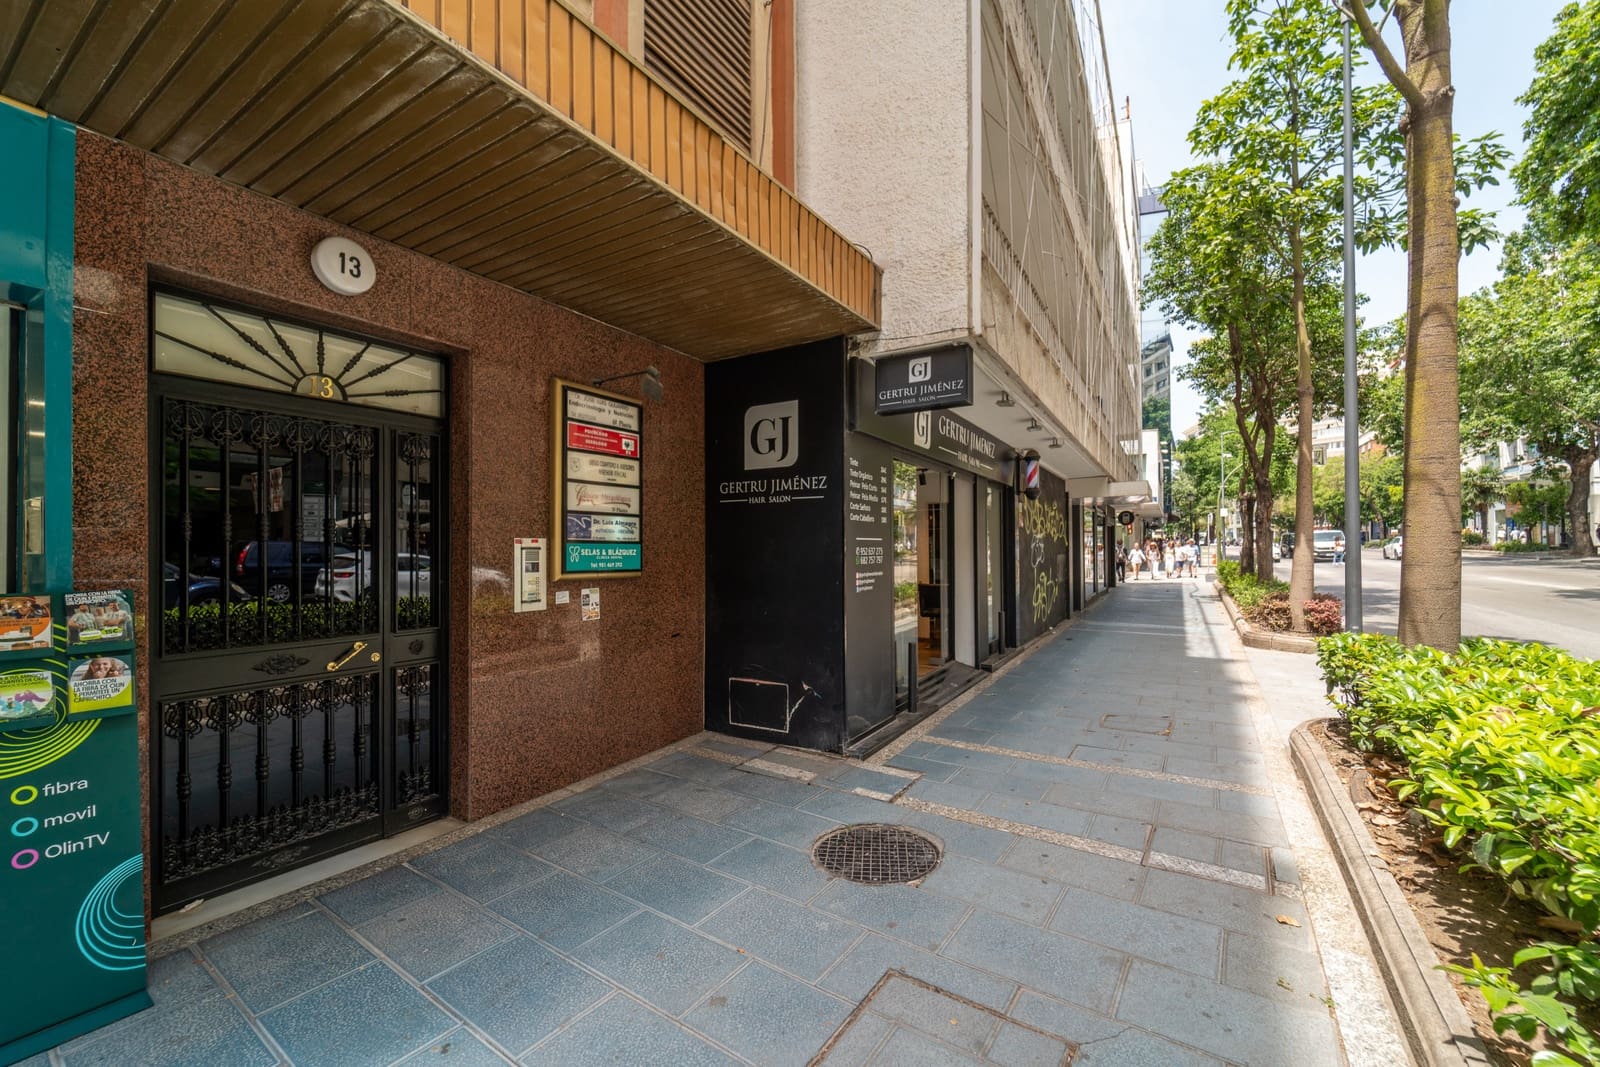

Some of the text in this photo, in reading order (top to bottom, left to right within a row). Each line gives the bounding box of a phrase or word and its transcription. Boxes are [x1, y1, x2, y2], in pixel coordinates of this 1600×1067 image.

[338, 252, 361, 278] 13
[911, 362, 928, 378] GJ
[310, 377, 334, 398] 13
[879, 380, 964, 400] GERTRU JIMÉNEZ
[750, 416, 792, 462] GJ
[939, 416, 970, 446] GERTRU
[720, 475, 828, 494] GERTRU JIMÉNEZ
[42, 780, 88, 796] fibra
[44, 805, 97, 828] movil
[45, 832, 110, 858] OlinTV
